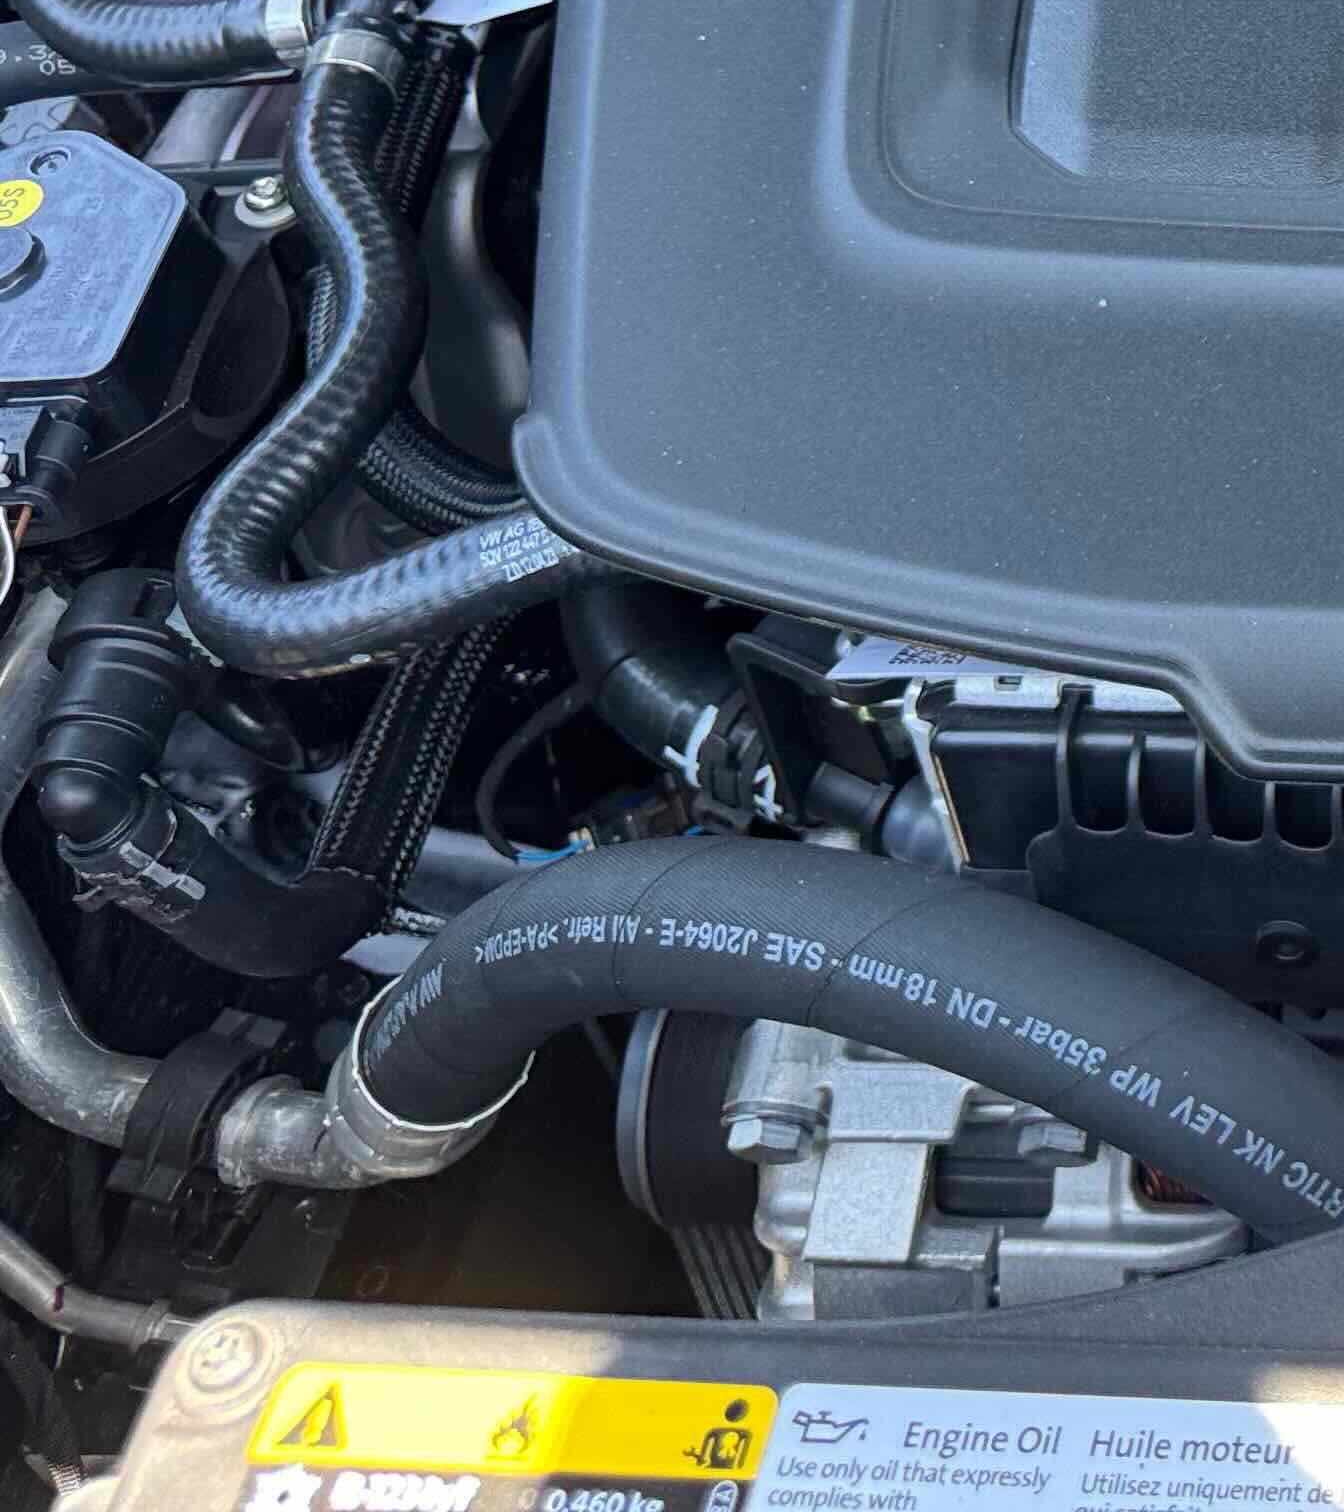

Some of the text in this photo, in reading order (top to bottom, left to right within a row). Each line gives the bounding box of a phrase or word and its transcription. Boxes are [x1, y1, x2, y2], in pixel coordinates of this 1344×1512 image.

[562, 914, 606, 945] Refr.
[659, 918, 758, 956] J2064-E
[763, 932, 826, 972] SAE
[945, 986, 998, 1030] DN
[1014, 1016, 1108, 1076] 35bar
[1108, 1064, 1162, 1108] WP
[1168, 1094, 1238, 1145] LEV
[1233, 1128, 1286, 1174] NK
[903, 1420, 1063, 1459] Engine Oil
[1089, 1428, 1296, 1466] Huile moteur
[776, 1455, 1053, 1496] Use only oil that expressly
[1080, 1472, 1161, 1497] Utilisez
[1166, 1478, 1304, 1507] uniquement
[1306, 1481, 1334, 1504] de
[767, 1485, 862, 1512] complies
[868, 1488, 918, 1512] with
